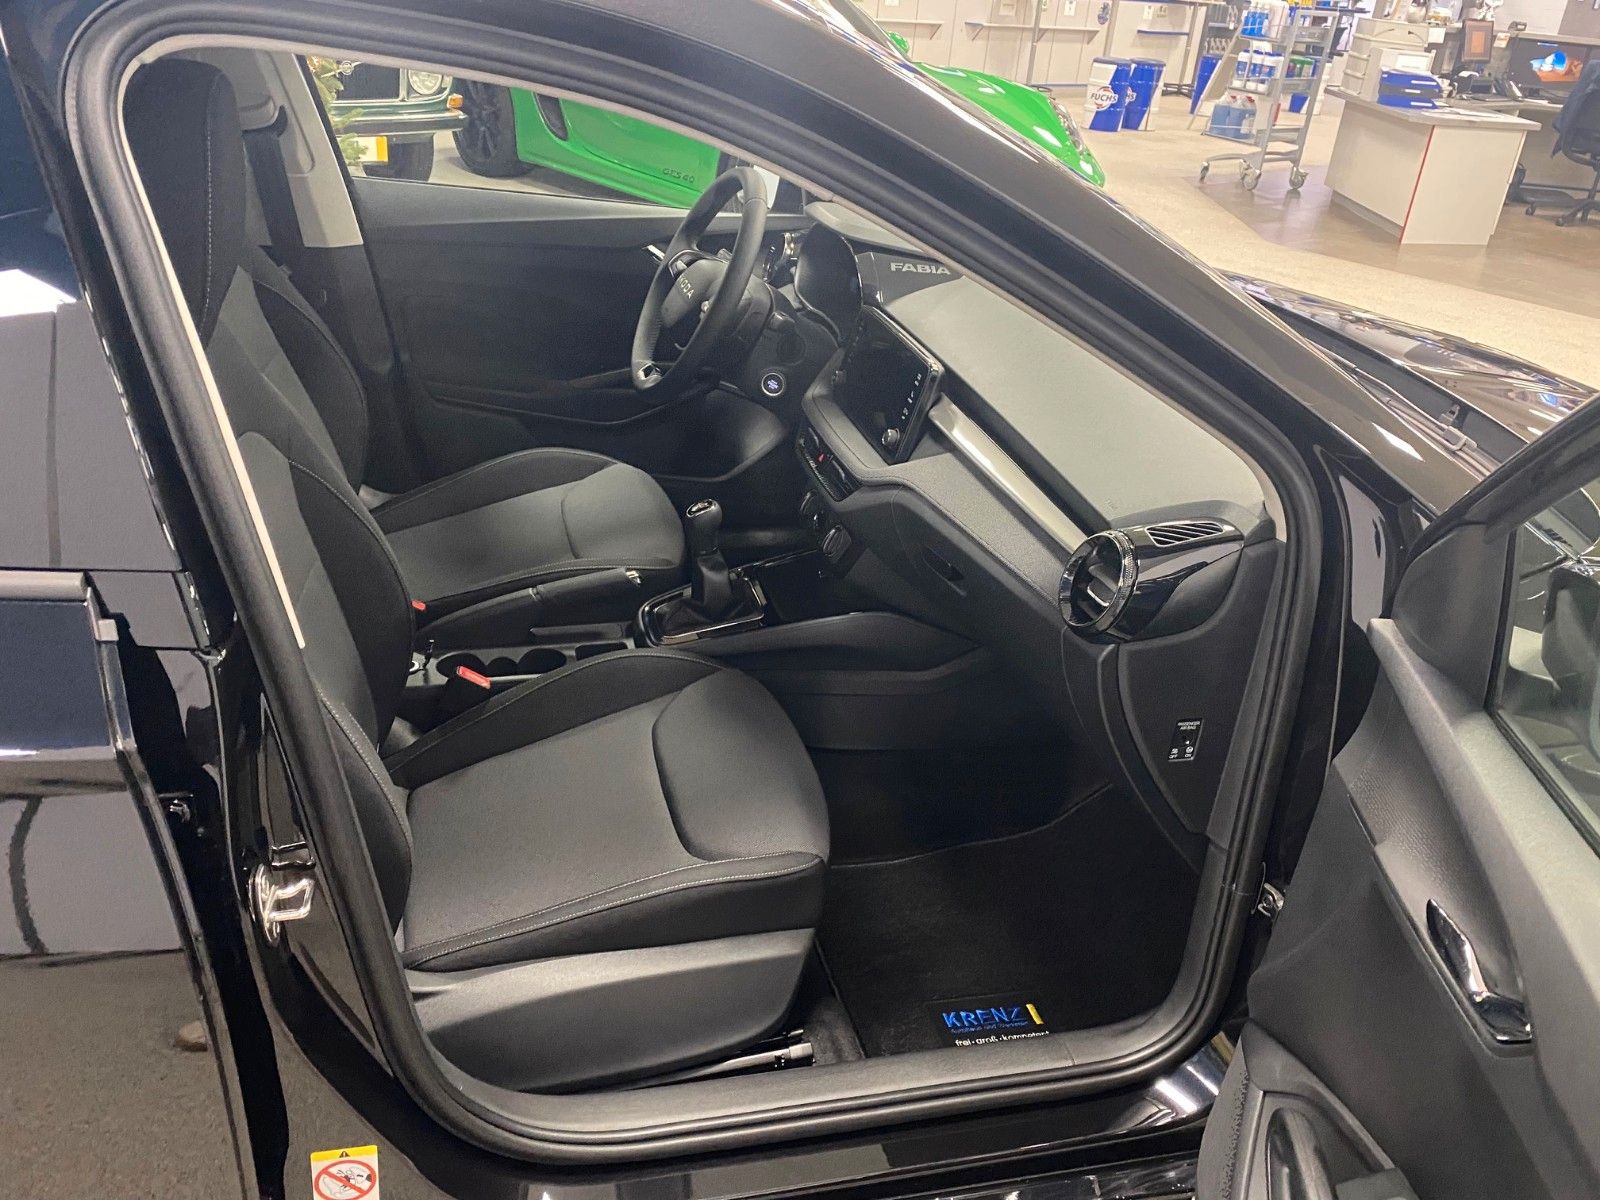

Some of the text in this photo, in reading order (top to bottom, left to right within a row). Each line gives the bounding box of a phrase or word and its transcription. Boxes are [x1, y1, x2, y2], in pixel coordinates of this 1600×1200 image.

[1090, 92, 1118, 102] FUCHS
[890, 262, 951, 275] FABIA
[942, 1006, 1027, 1028] KRENZ
